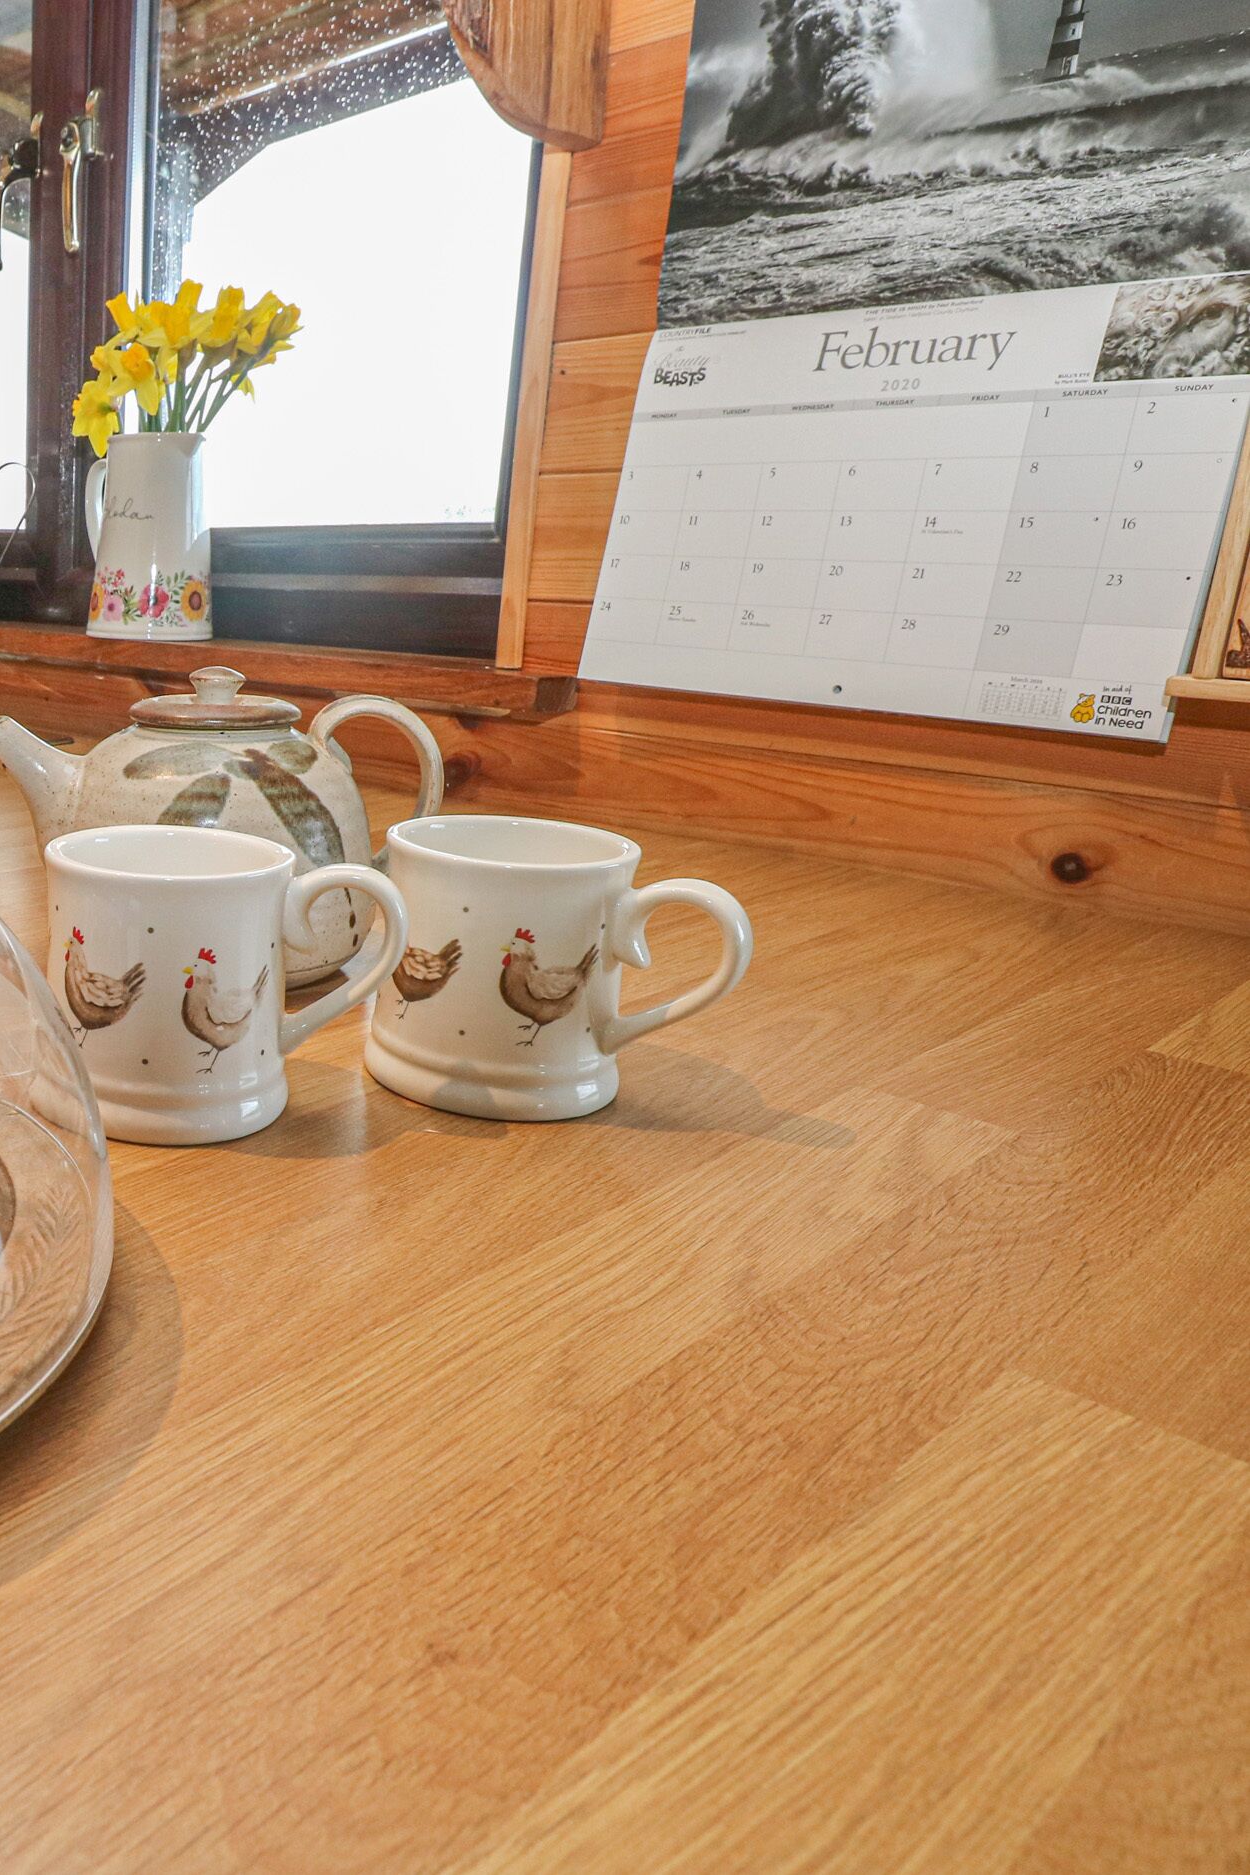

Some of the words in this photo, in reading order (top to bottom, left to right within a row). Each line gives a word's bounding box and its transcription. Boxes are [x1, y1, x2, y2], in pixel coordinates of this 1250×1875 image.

[659, 327, 712, 338] COUNTRYFILE
[812, 326, 1016, 372] February
[881, 378, 921, 392] 2020
[651, 412, 678, 420] MONDAY
[722, 408, 751, 416] TUESDAY
[791, 403, 835, 411] WEDNESDAY
[875, 399, 915, 407] THURSDAY
[971, 394, 1000, 402] FRIDAY
[1062, 388, 1109, 398] SATURDAY
[1174, 383, 1215, 392] SUNDAY
[1043, 406, 1050, 418] 1
[1146, 402, 1156, 414] 2
[629, 471, 634, 480] 3
[696, 470, 703, 480] 4
[770, 467, 776, 478] 5
[848, 465, 856, 476] 6
[935, 463, 942, 476] 7
[1030, 461, 1039, 473] 8
[1133, 460, 1143, 472] 9
[619, 515, 630, 525] 10
[688, 515, 698, 526] 11
[761, 515, 773, 526] 12
[840, 516, 852, 527] 13
[924, 516, 937, 528] 14
[1018, 516, 1034, 528] 15
[1121, 517, 1136, 529] 16
[610, 559, 620, 568] 17
[680, 561, 690, 571] 18
[752, 563, 764, 573] 19
[829, 565, 844, 576] 20
[912, 568, 925, 579] 21
[1005, 571, 1022, 583] 22
[1106, 574, 1123, 586] 23
[600, 601, 611, 611] 24
[669, 605, 682, 616] 25
[741, 610, 754, 620] 26
[819, 614, 832, 625] 27
[902, 618, 917, 630] 28
[993, 624, 1010, 636] 29
[1124, 684, 1132, 694] of
[1101, 695, 1132, 705] BBC
[1097, 705, 1152, 719] Children
[1095, 715, 1106, 725] in
[1108, 717, 1144, 729] Need
